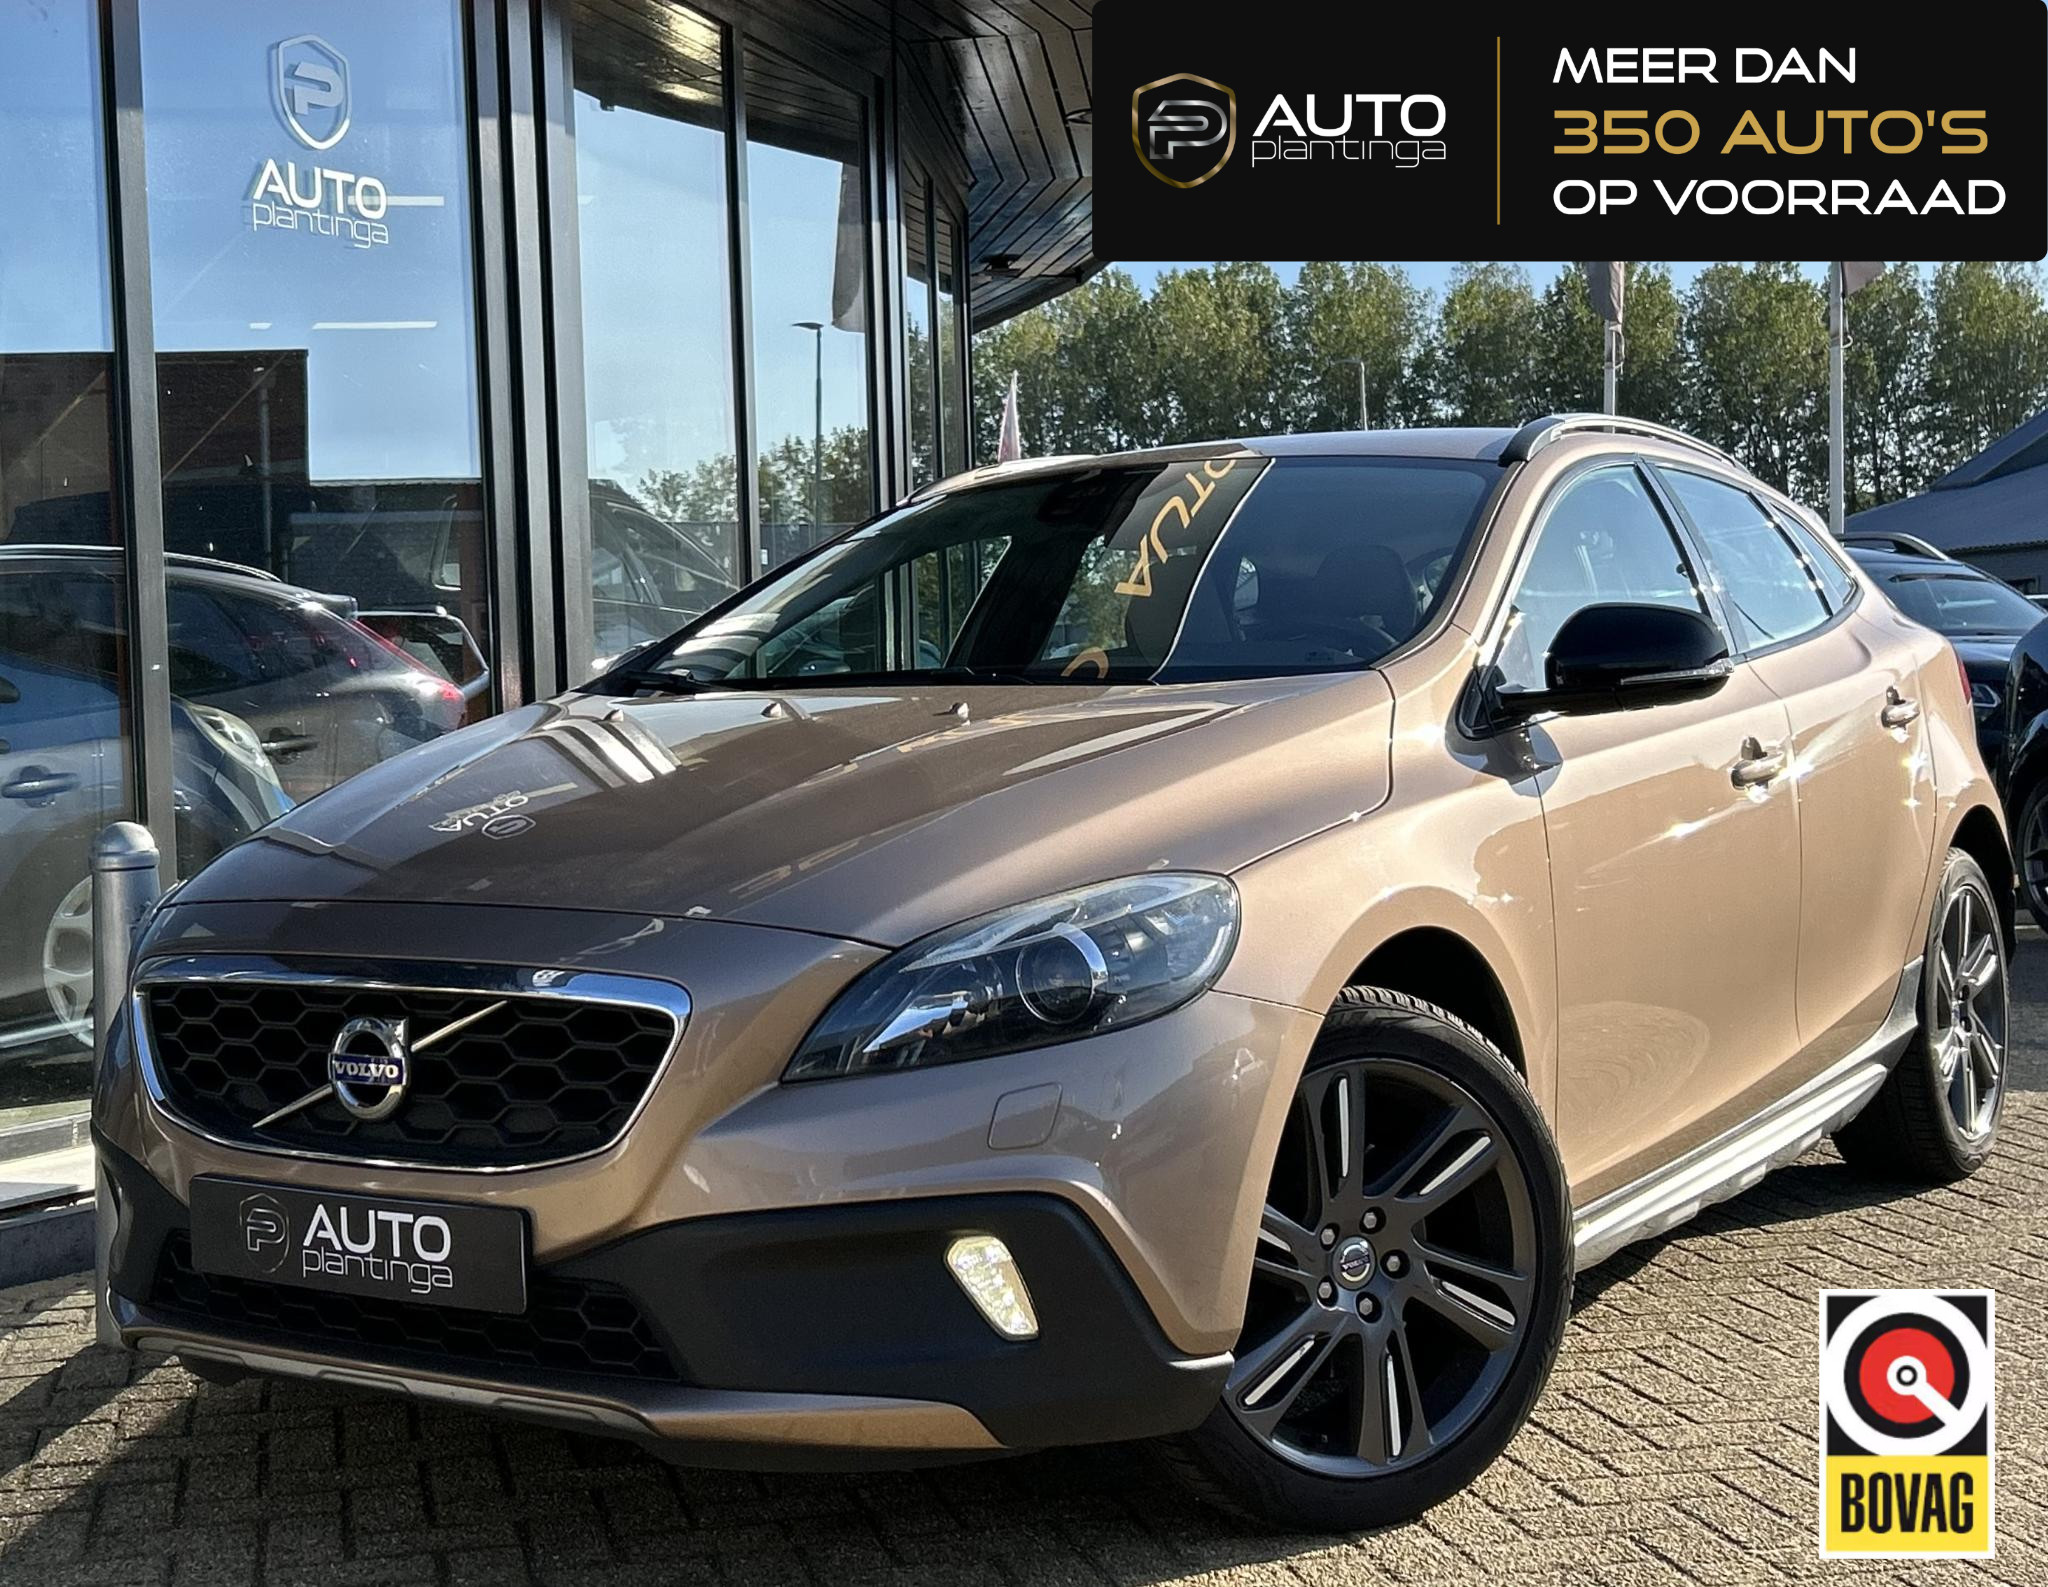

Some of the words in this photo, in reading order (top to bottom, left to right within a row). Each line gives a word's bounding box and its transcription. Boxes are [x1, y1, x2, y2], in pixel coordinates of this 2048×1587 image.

[253, 158, 388, 219] AUTO
[252, 200, 389, 248] plantinga
[334, 1060, 399, 1079] VOLVO
[303, 1203, 451, 1262] AUTO
[302, 1247, 453, 1294] plantinga
